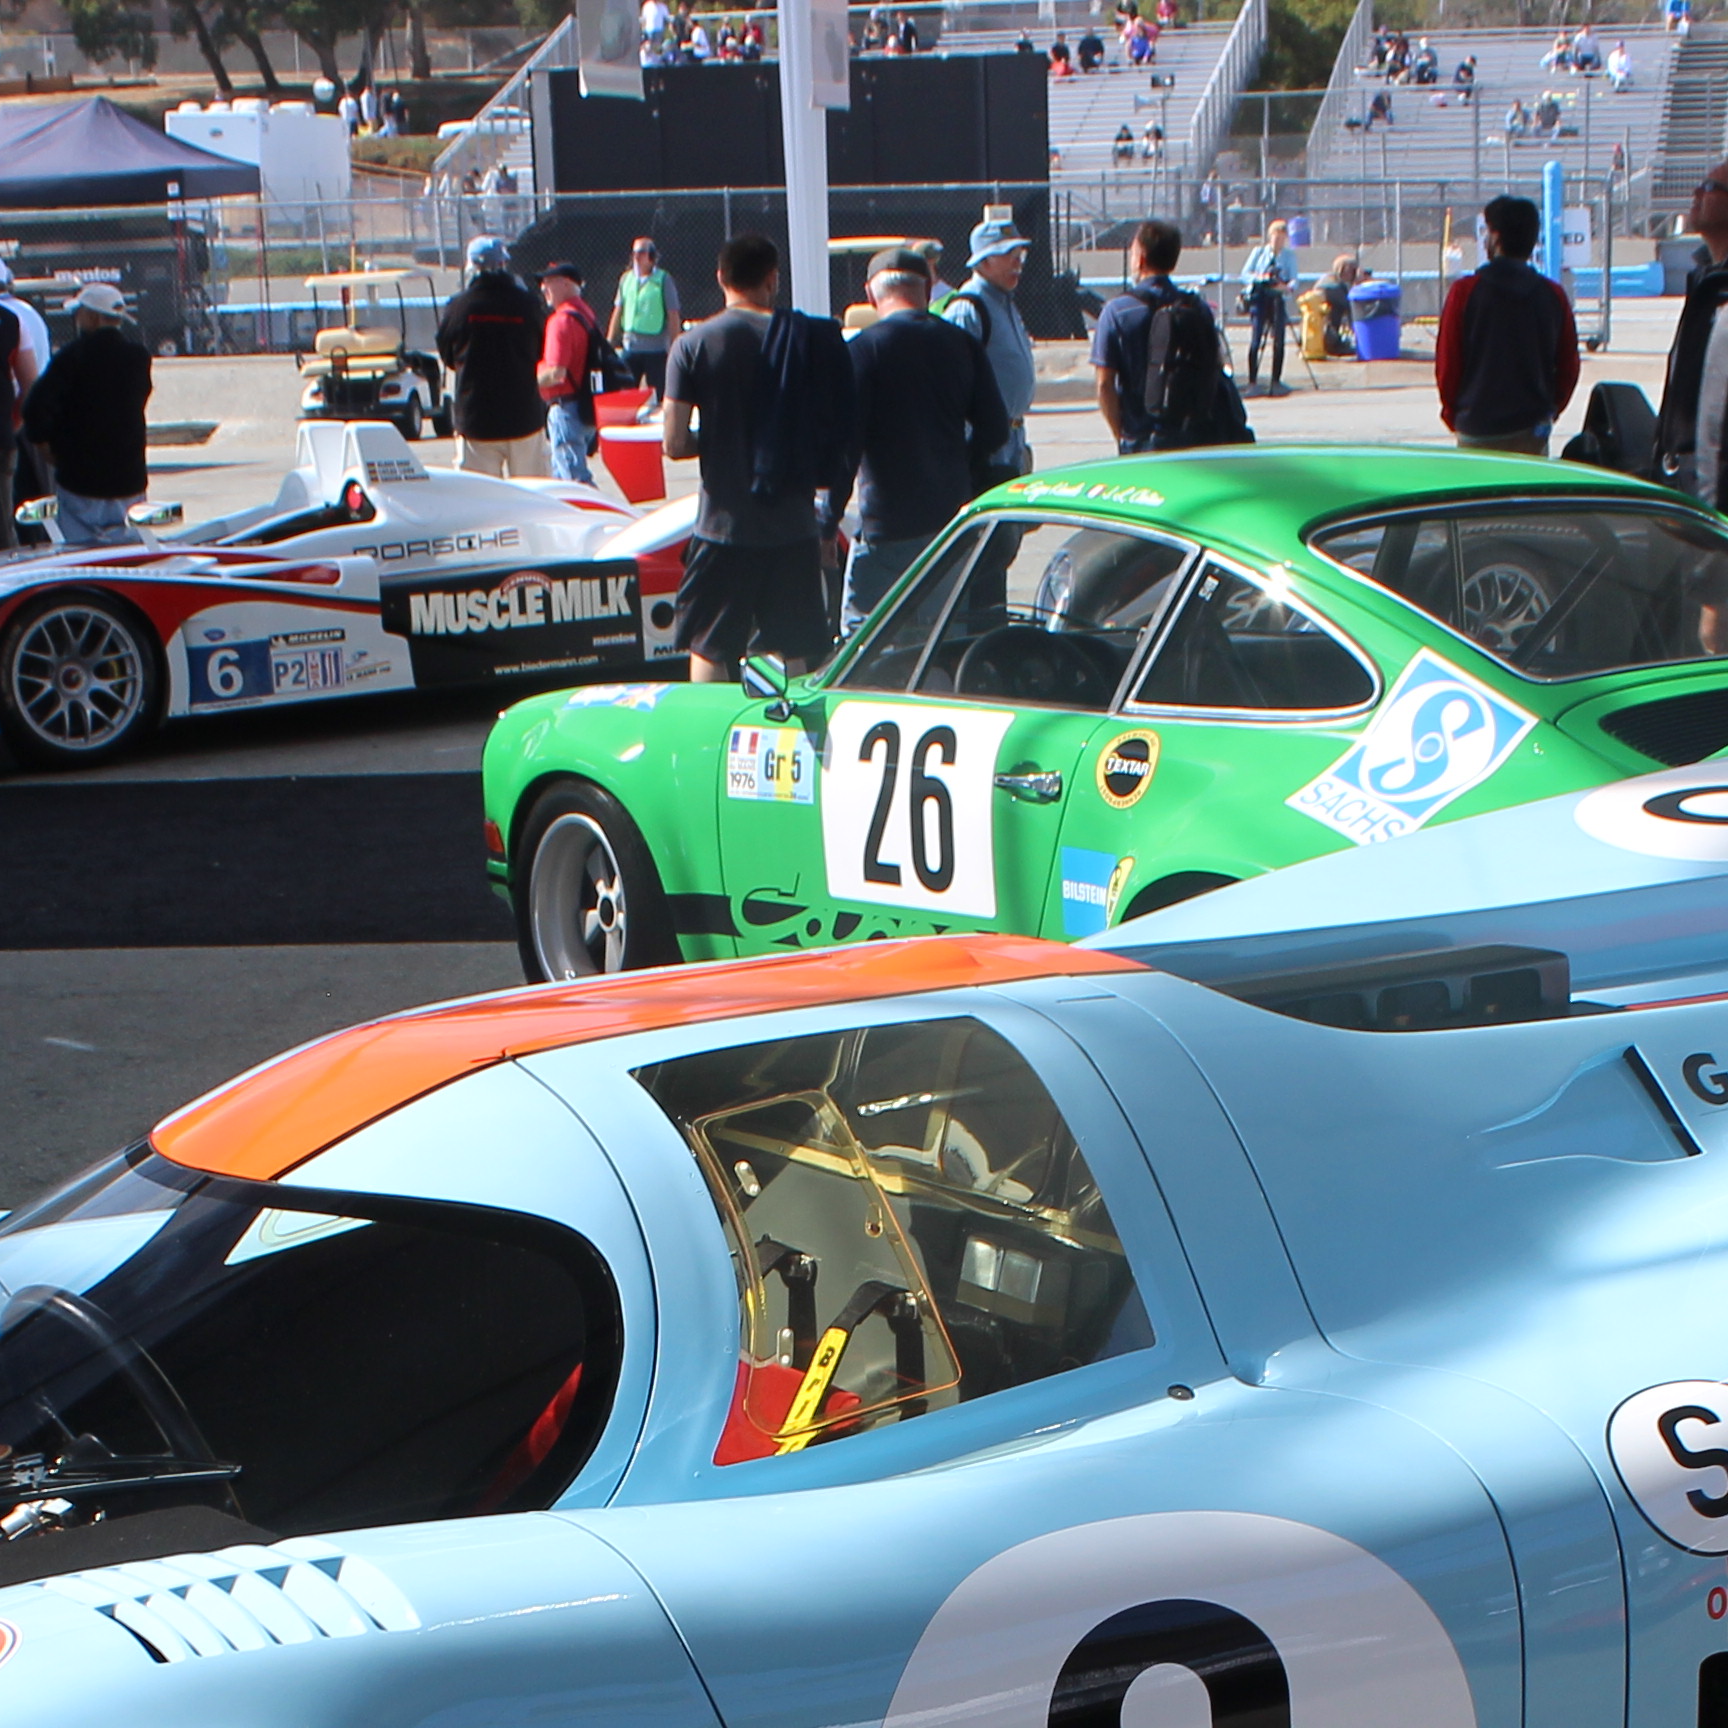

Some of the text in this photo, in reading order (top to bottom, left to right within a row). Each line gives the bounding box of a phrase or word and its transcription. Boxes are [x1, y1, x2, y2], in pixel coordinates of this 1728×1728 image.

[353, 528, 520, 560] PORSCHE
[409, 575, 633, 636] MUSCLE MILK
[288, 630, 342, 644] MICHELIN
[207, 648, 245, 698] 6
[274, 660, 307, 689] P2
[729, 771, 756, 790] 1976
[764, 747, 786, 781] Gr
[791, 750, 802, 783] 5
[1106, 755, 1150, 777] TEXTAR
[858, 720, 958, 894] 26
[1299, 780, 1406, 843] SACHS
[1062, 879, 1107, 907] BILSTEIN
